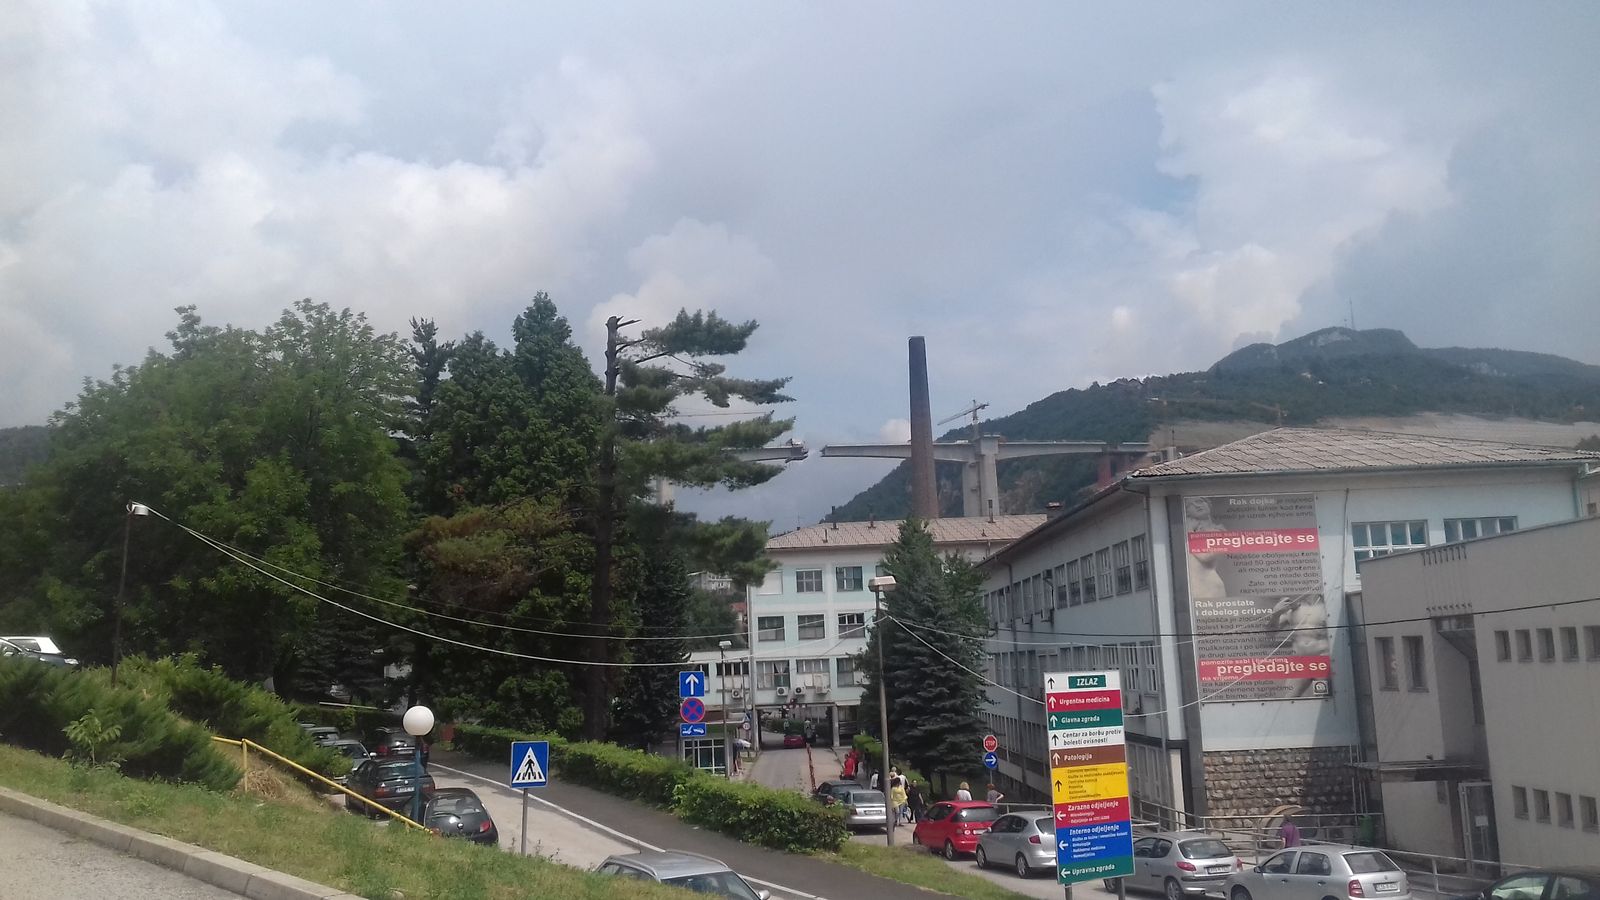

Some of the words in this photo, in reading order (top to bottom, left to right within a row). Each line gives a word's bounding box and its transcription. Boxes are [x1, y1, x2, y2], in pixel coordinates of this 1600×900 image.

[1206, 534, 1293, 549] pregledajte
[1297, 534, 1315, 543] se
[1216, 600, 1254, 608] prostate
[1202, 608, 1239, 616] debelog
[1241, 607, 1273, 615] crijeva
[1217, 662, 1304, 676] pregledajte
[1309, 661, 1328, 671] se
[1077, 678, 1098, 686] IZLAZ
[1064, 753, 1092, 761] Patologija
[1091, 801, 1119, 809] odjeljenje
[1092, 824, 1119, 833] odjeljenje
[1072, 867, 1095, 875] Upravna
[1096, 864, 1115, 872] zgrada
